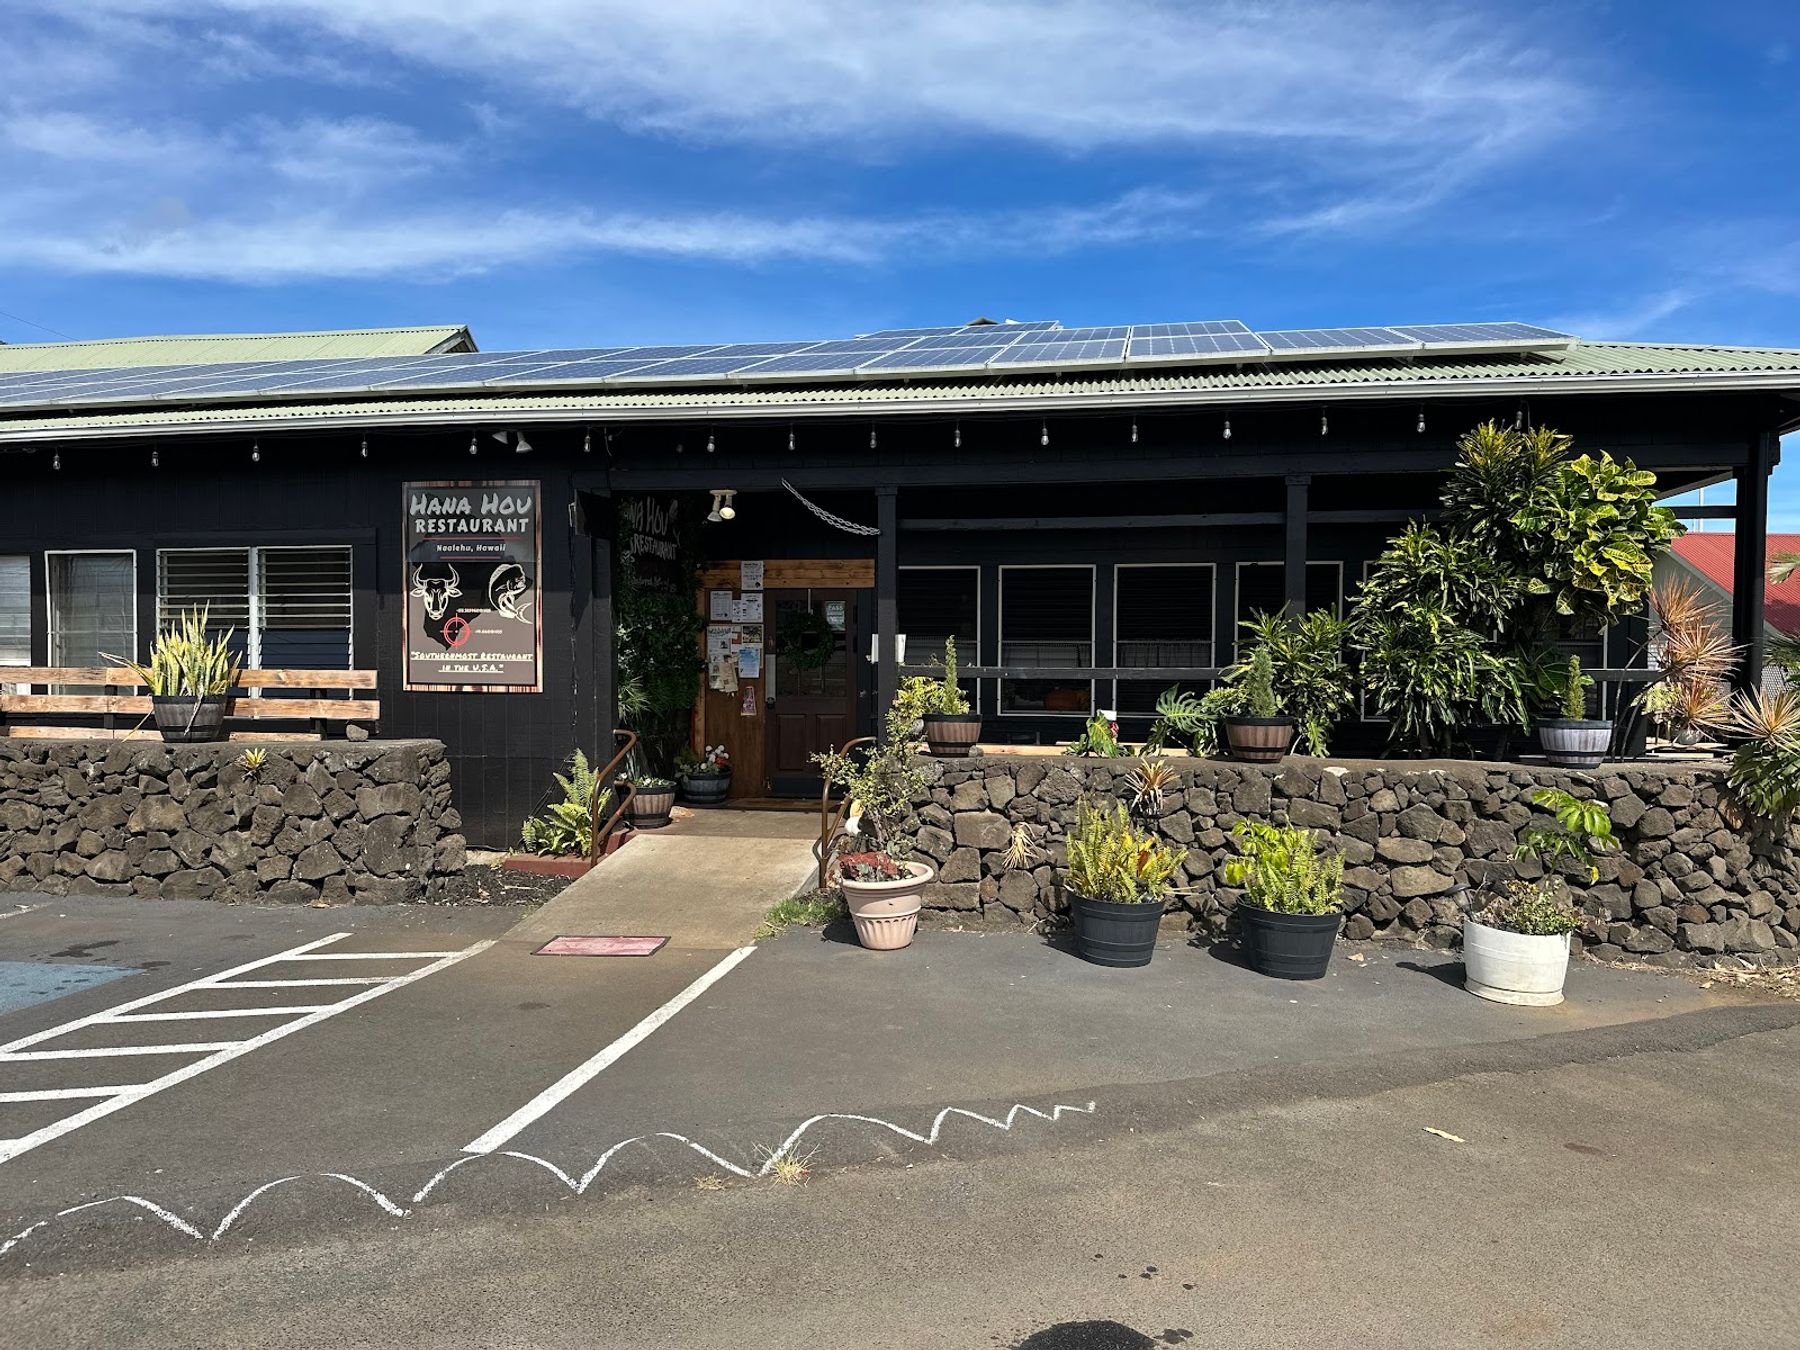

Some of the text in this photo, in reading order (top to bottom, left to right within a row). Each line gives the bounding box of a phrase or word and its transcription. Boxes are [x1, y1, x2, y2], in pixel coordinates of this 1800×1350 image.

[410, 493, 532, 516] HANA HOU
[415, 518, 529, 533] RESTAURANT
[476, 544, 506, 552] Hawaii
[480, 651, 533, 660] RESTAURANT
[442, 664, 451, 672] IN
[454, 664, 470, 672] THE
